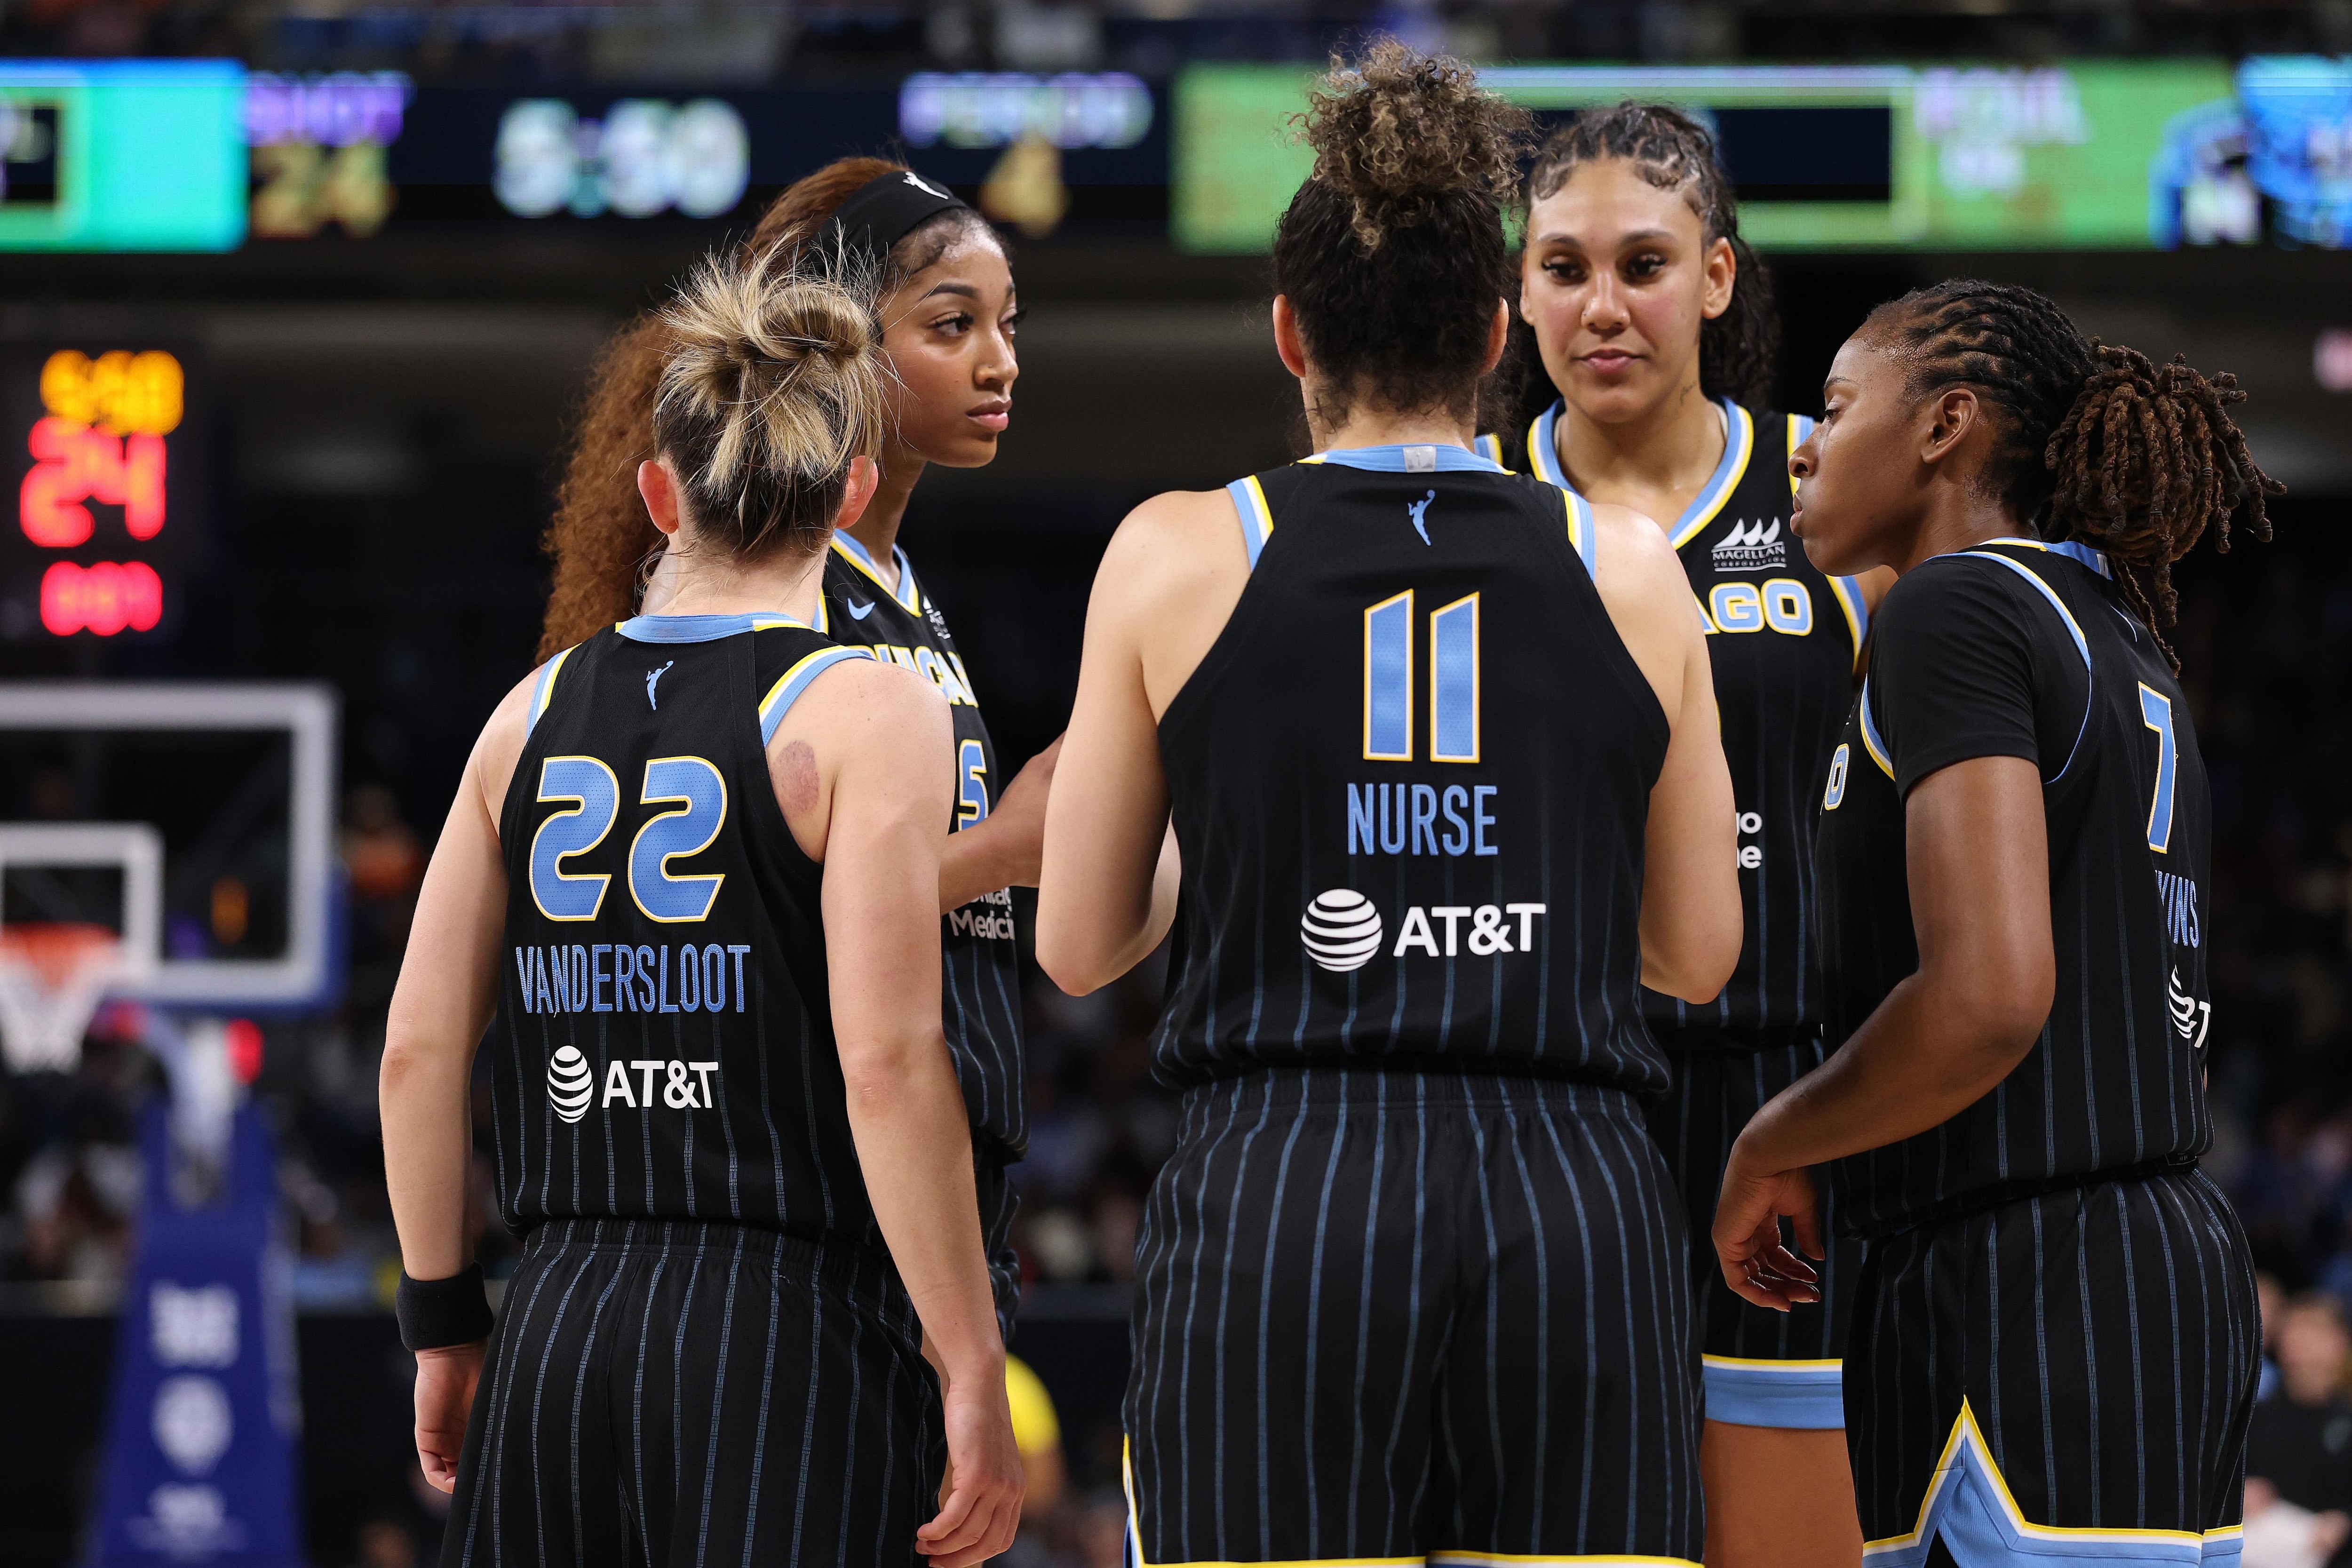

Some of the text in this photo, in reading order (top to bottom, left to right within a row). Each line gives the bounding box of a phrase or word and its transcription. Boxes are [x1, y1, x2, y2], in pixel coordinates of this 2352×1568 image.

[20, 416, 166, 547] 24
[1712, 544, 1786, 561] MAGELLAN
[1362, 588, 1480, 763] 11
[958, 739, 989, 832] 5
[2138, 681, 2176, 854] 7
[529, 755, 727, 923] 22
[1347, 783, 1498, 856] NURSE
[1392, 902, 1547, 958] AT&T
[516, 944, 751, 1013] VANDERSLOOT
[602, 1059, 719, 1109] AT&T
